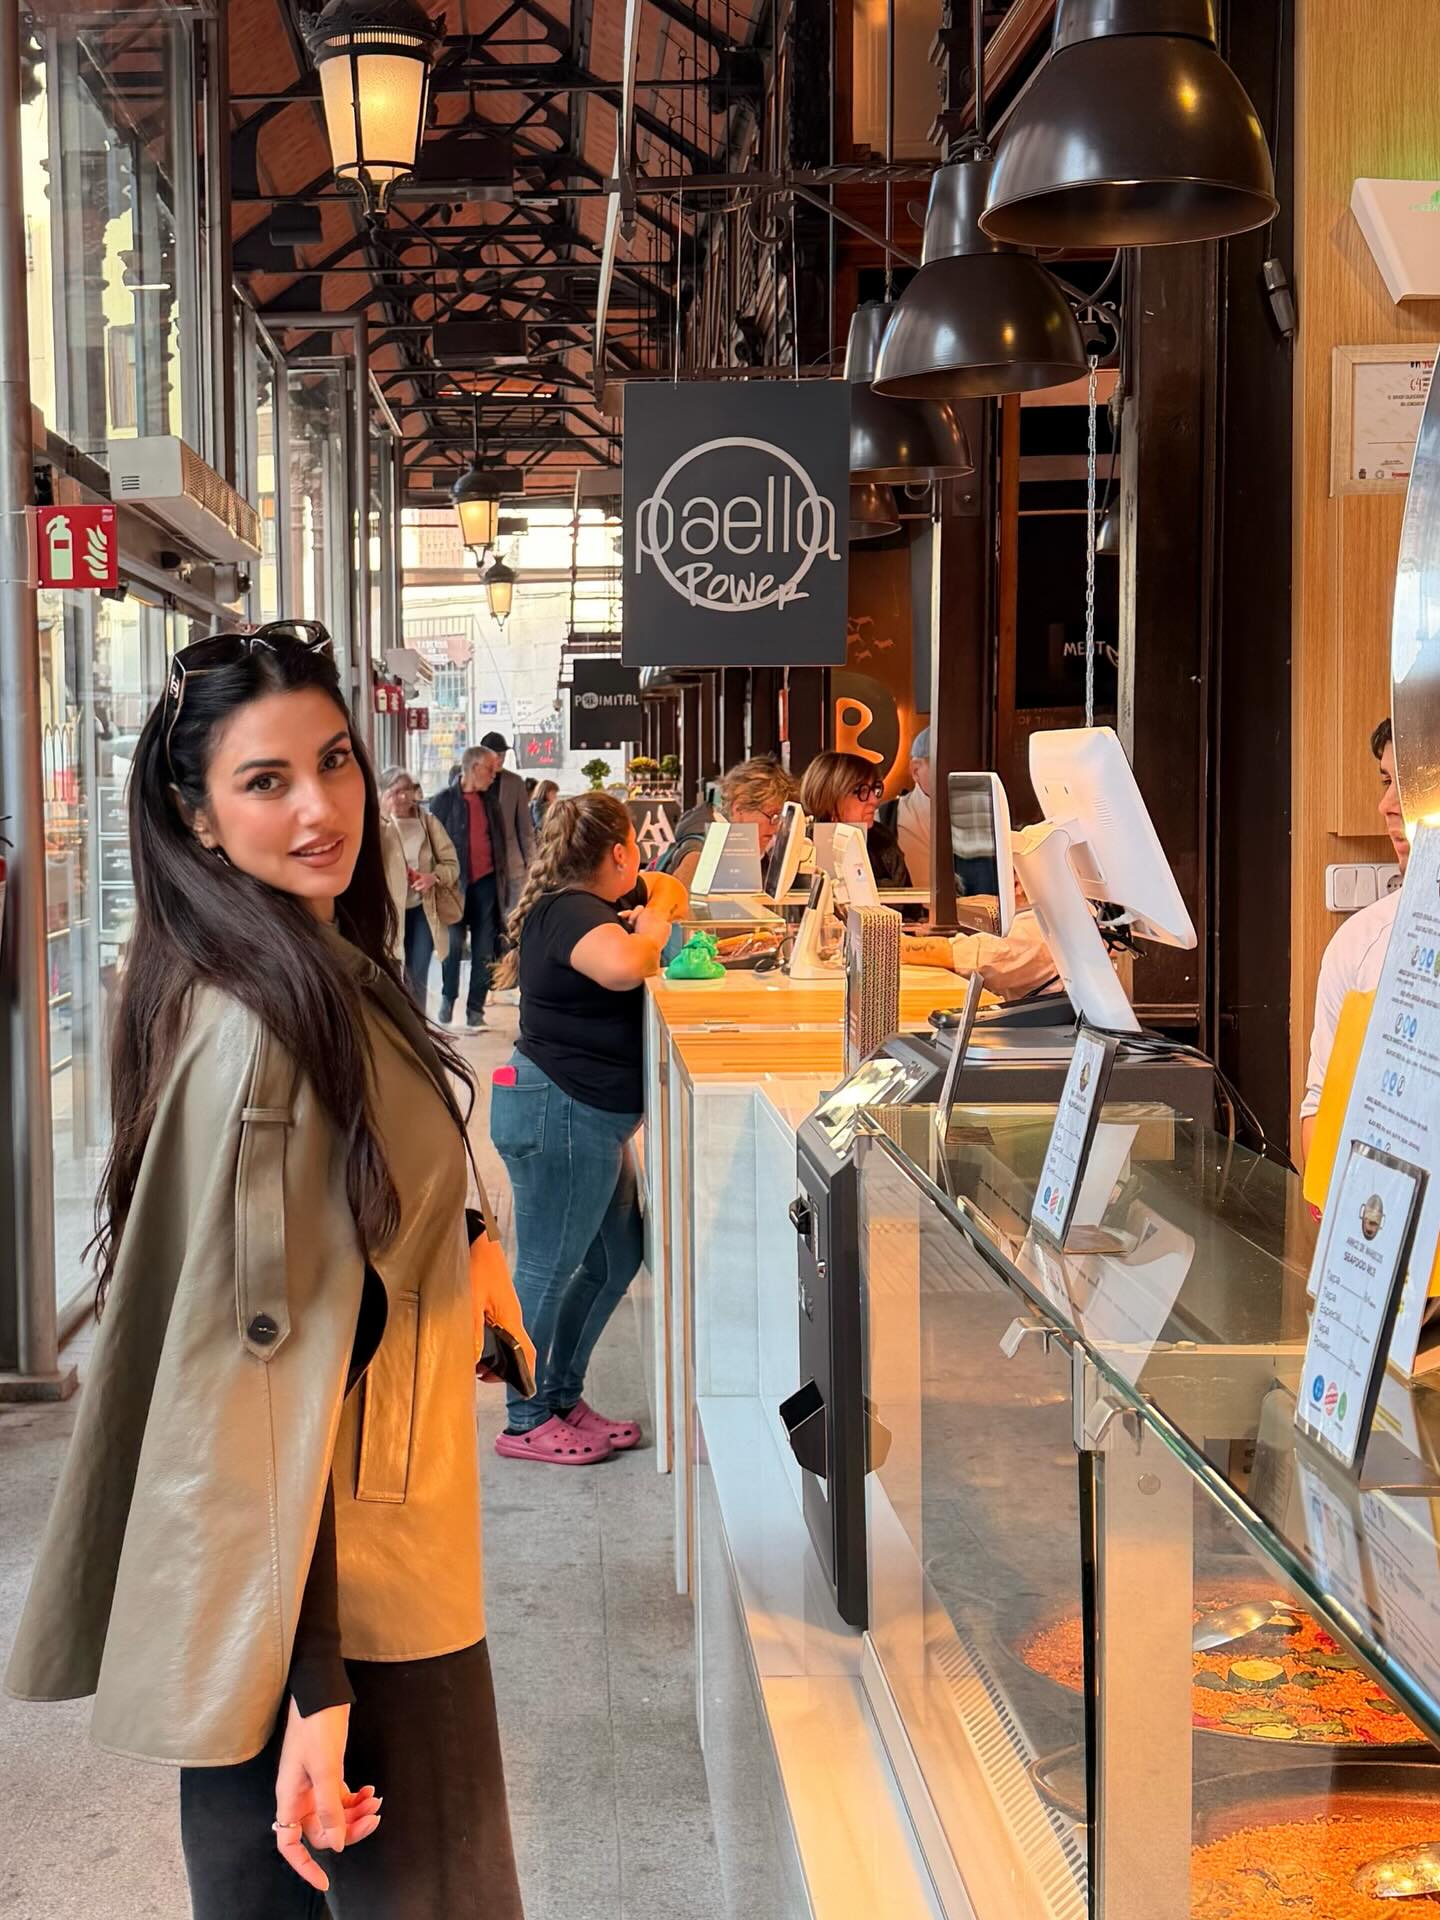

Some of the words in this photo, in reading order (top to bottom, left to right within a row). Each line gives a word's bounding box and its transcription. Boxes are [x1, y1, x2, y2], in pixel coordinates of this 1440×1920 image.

[636, 476, 841, 574] paella
[675, 562, 809, 610] Power
[1063, 641, 1106, 656] MET
